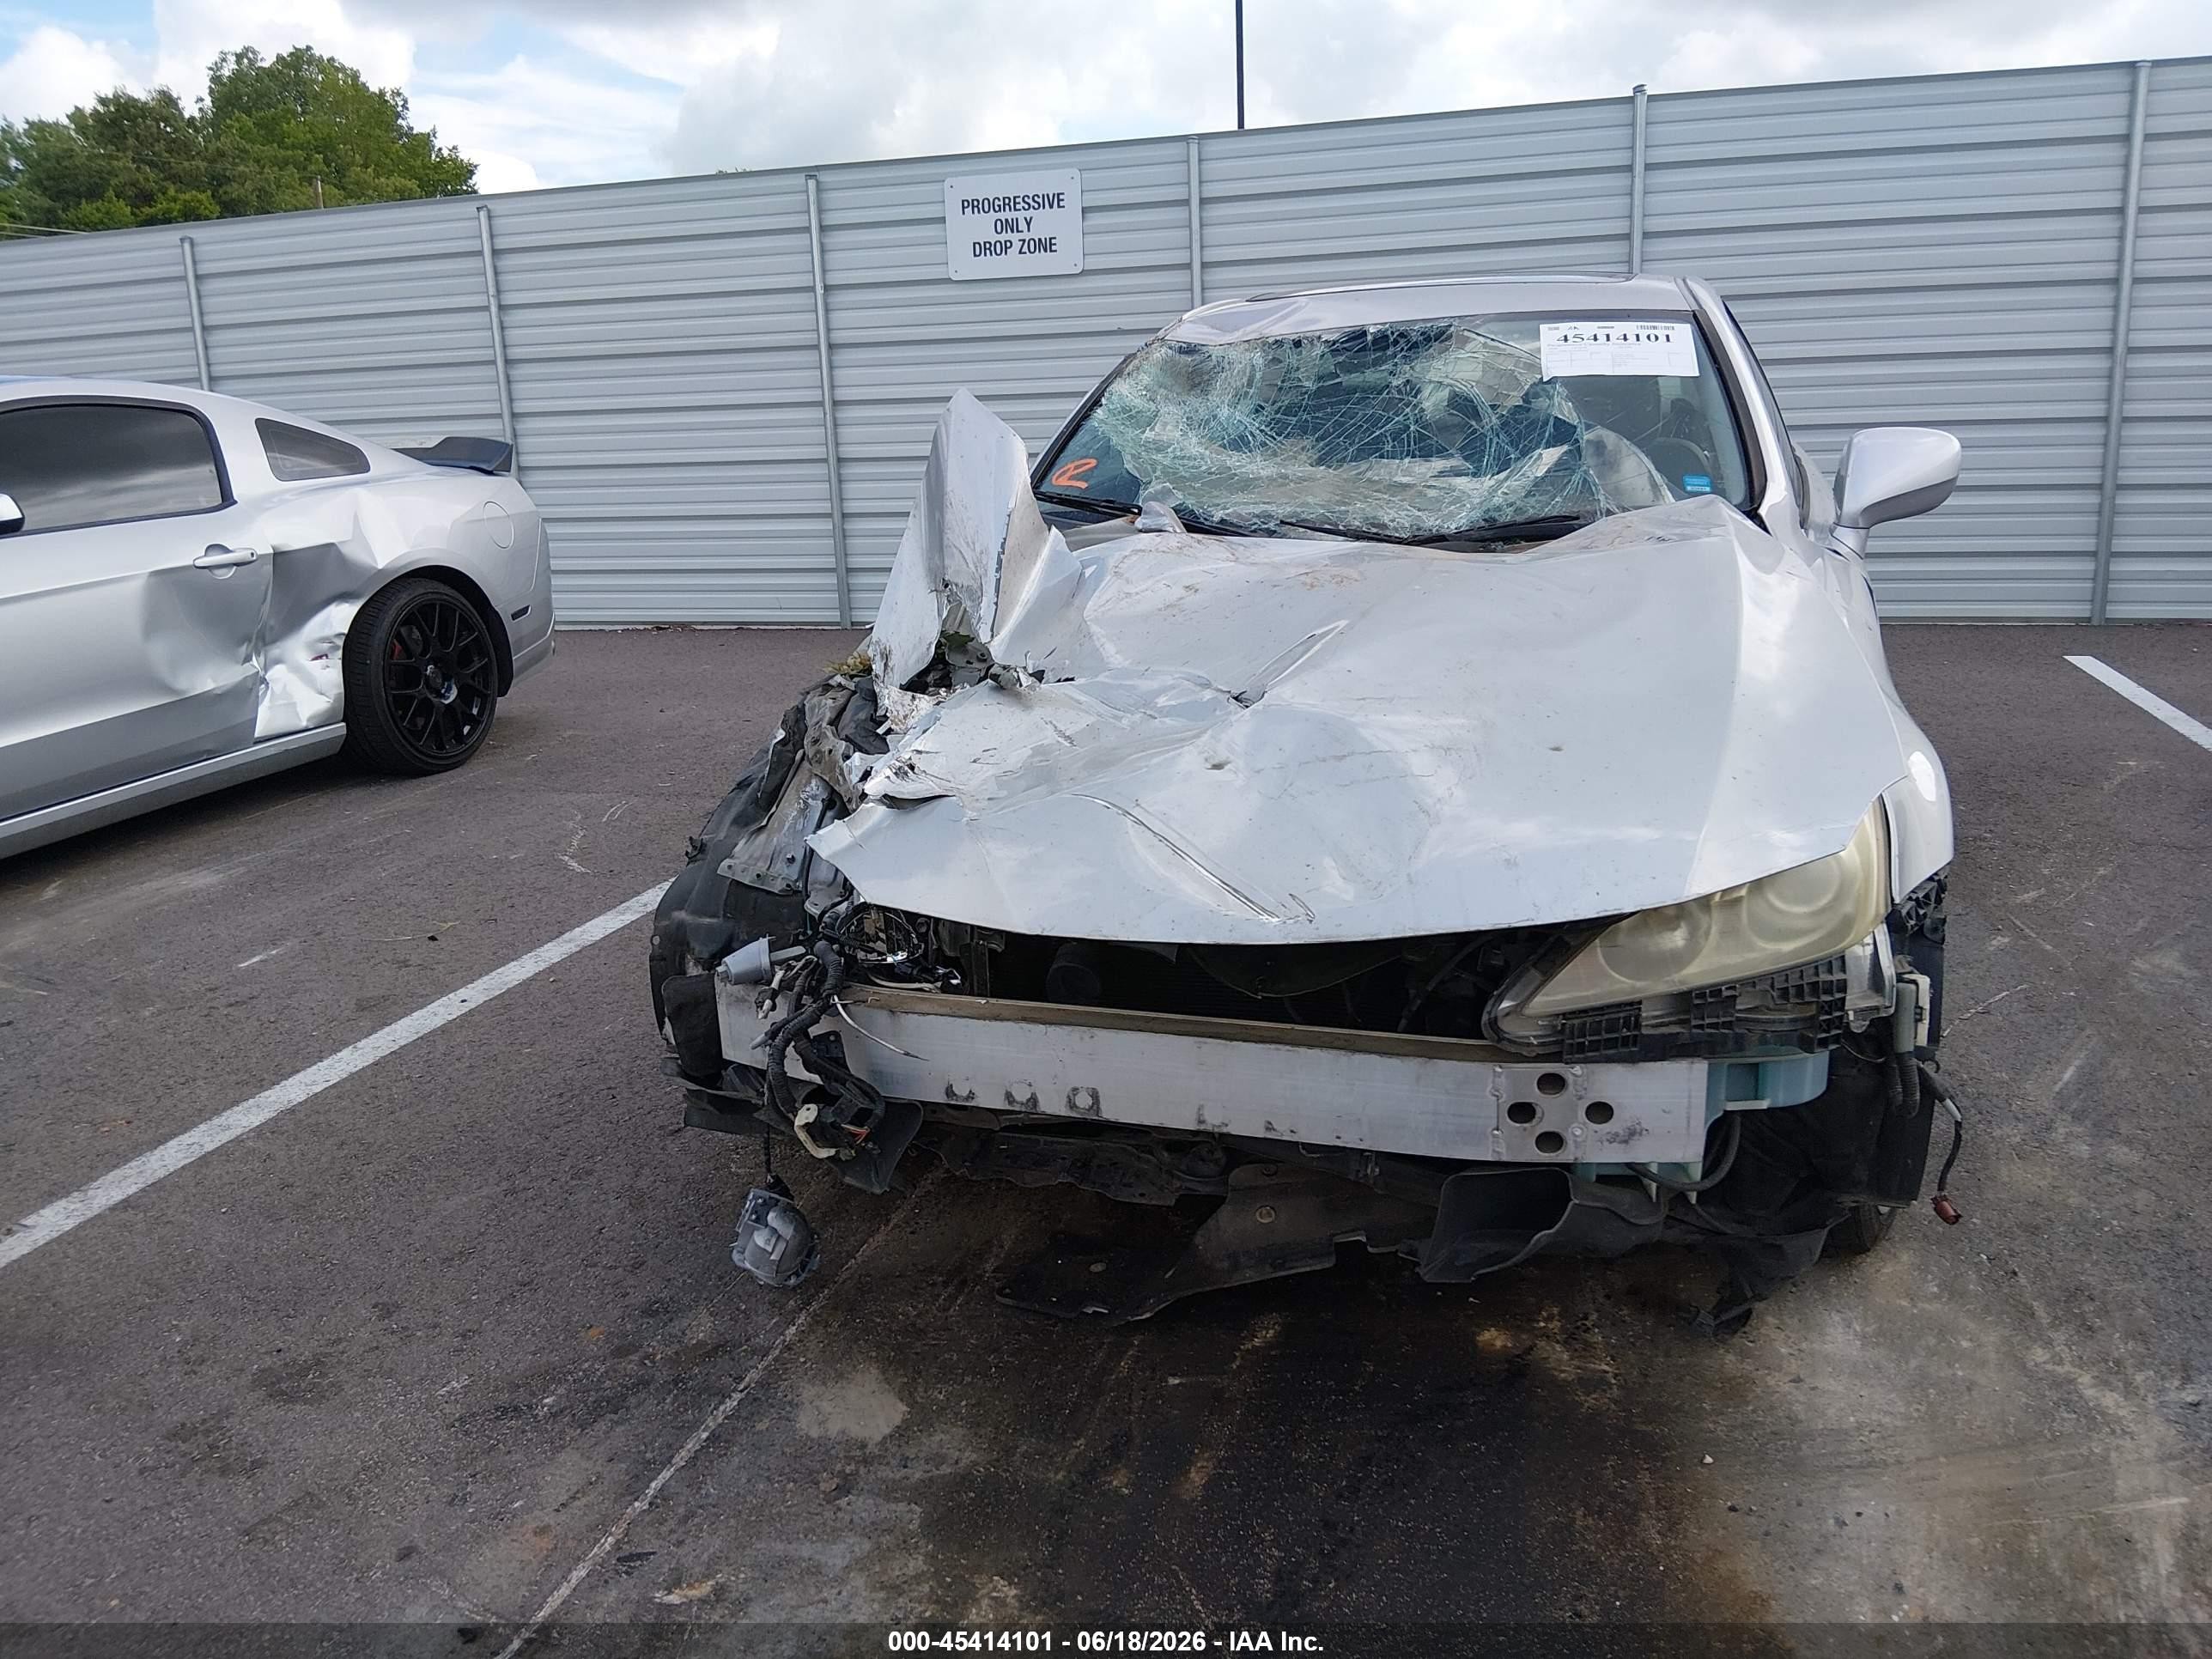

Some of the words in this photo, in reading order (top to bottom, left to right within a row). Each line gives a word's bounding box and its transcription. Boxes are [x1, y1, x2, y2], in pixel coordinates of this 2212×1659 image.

[961, 192, 1066, 216] PROGRESSIVE
[994, 216, 1033, 234] ONLY
[972, 240, 1013, 258] DROP
[1018, 237, 1058, 255] ZONE
[1556, 332, 1675, 343] 45414101
